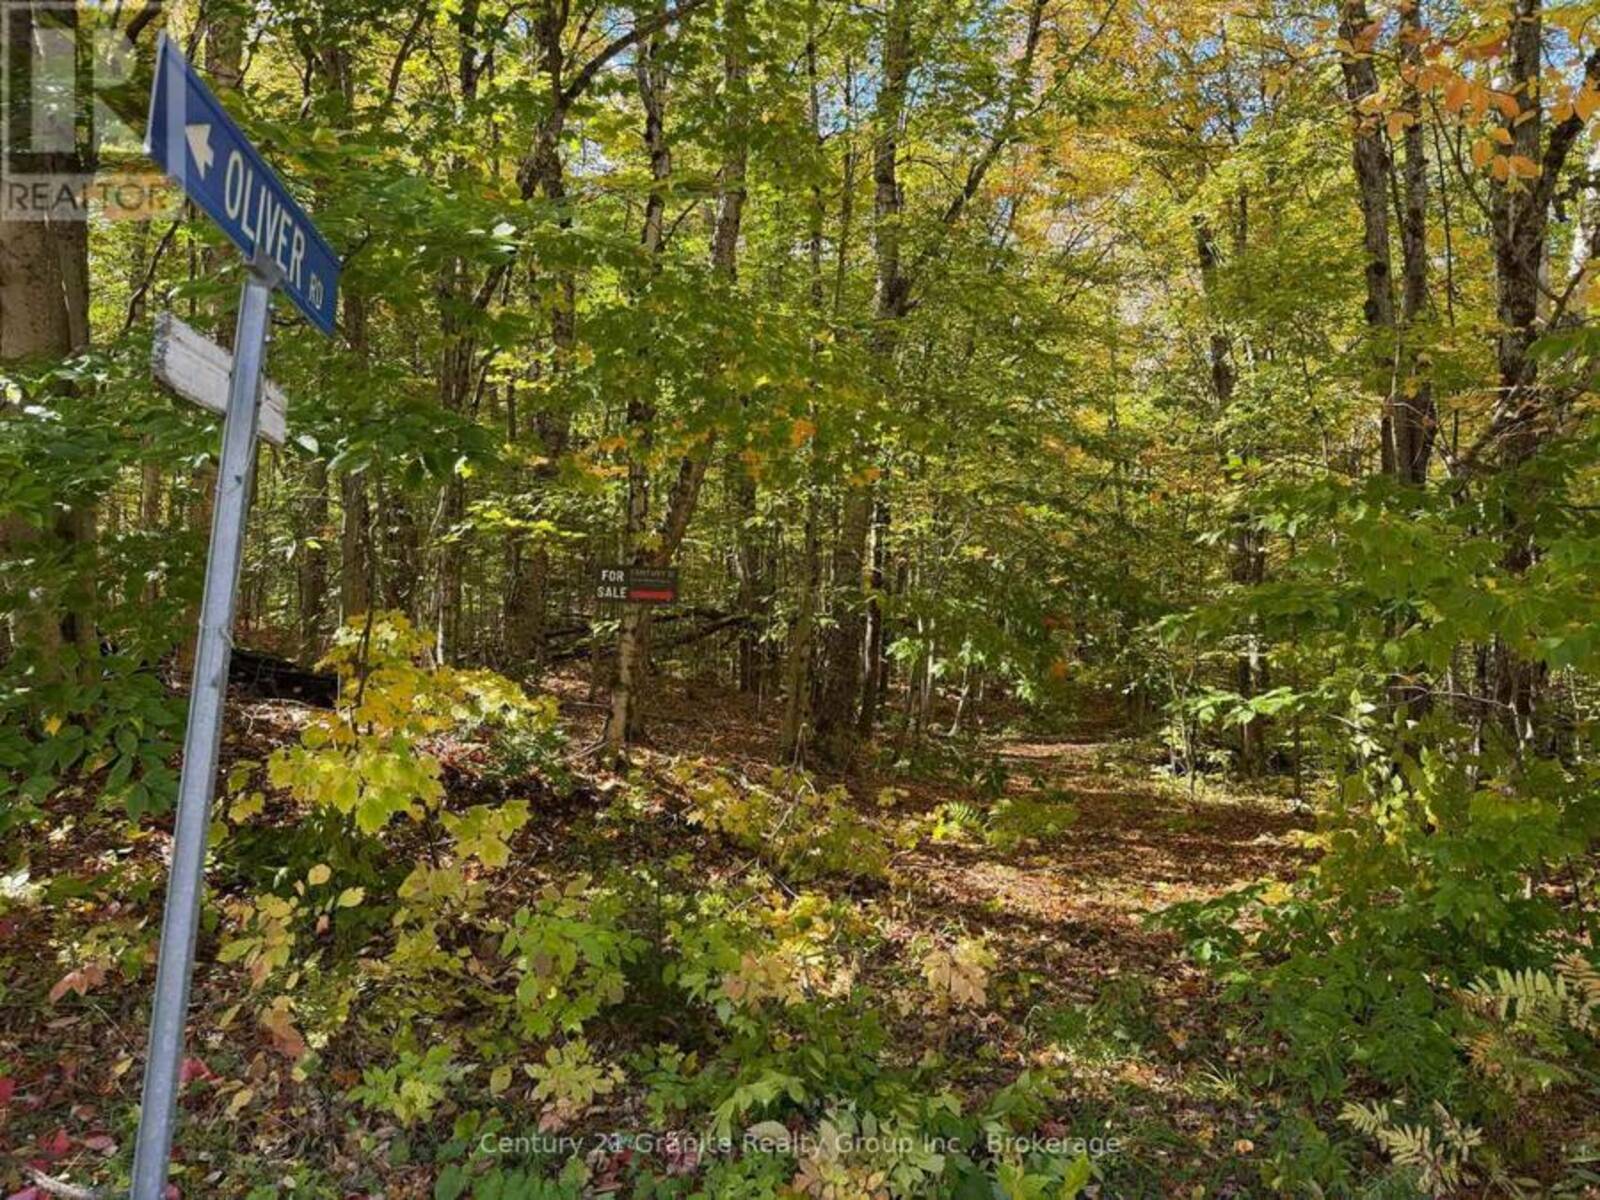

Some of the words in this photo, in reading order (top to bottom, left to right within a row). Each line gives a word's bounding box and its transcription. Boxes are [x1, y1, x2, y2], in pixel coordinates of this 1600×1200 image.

[225, 150, 305, 289] OLIVER
[309, 273, 324, 310] RD
[601, 570, 624, 582] FOR
[597, 586, 627, 599] SALE
